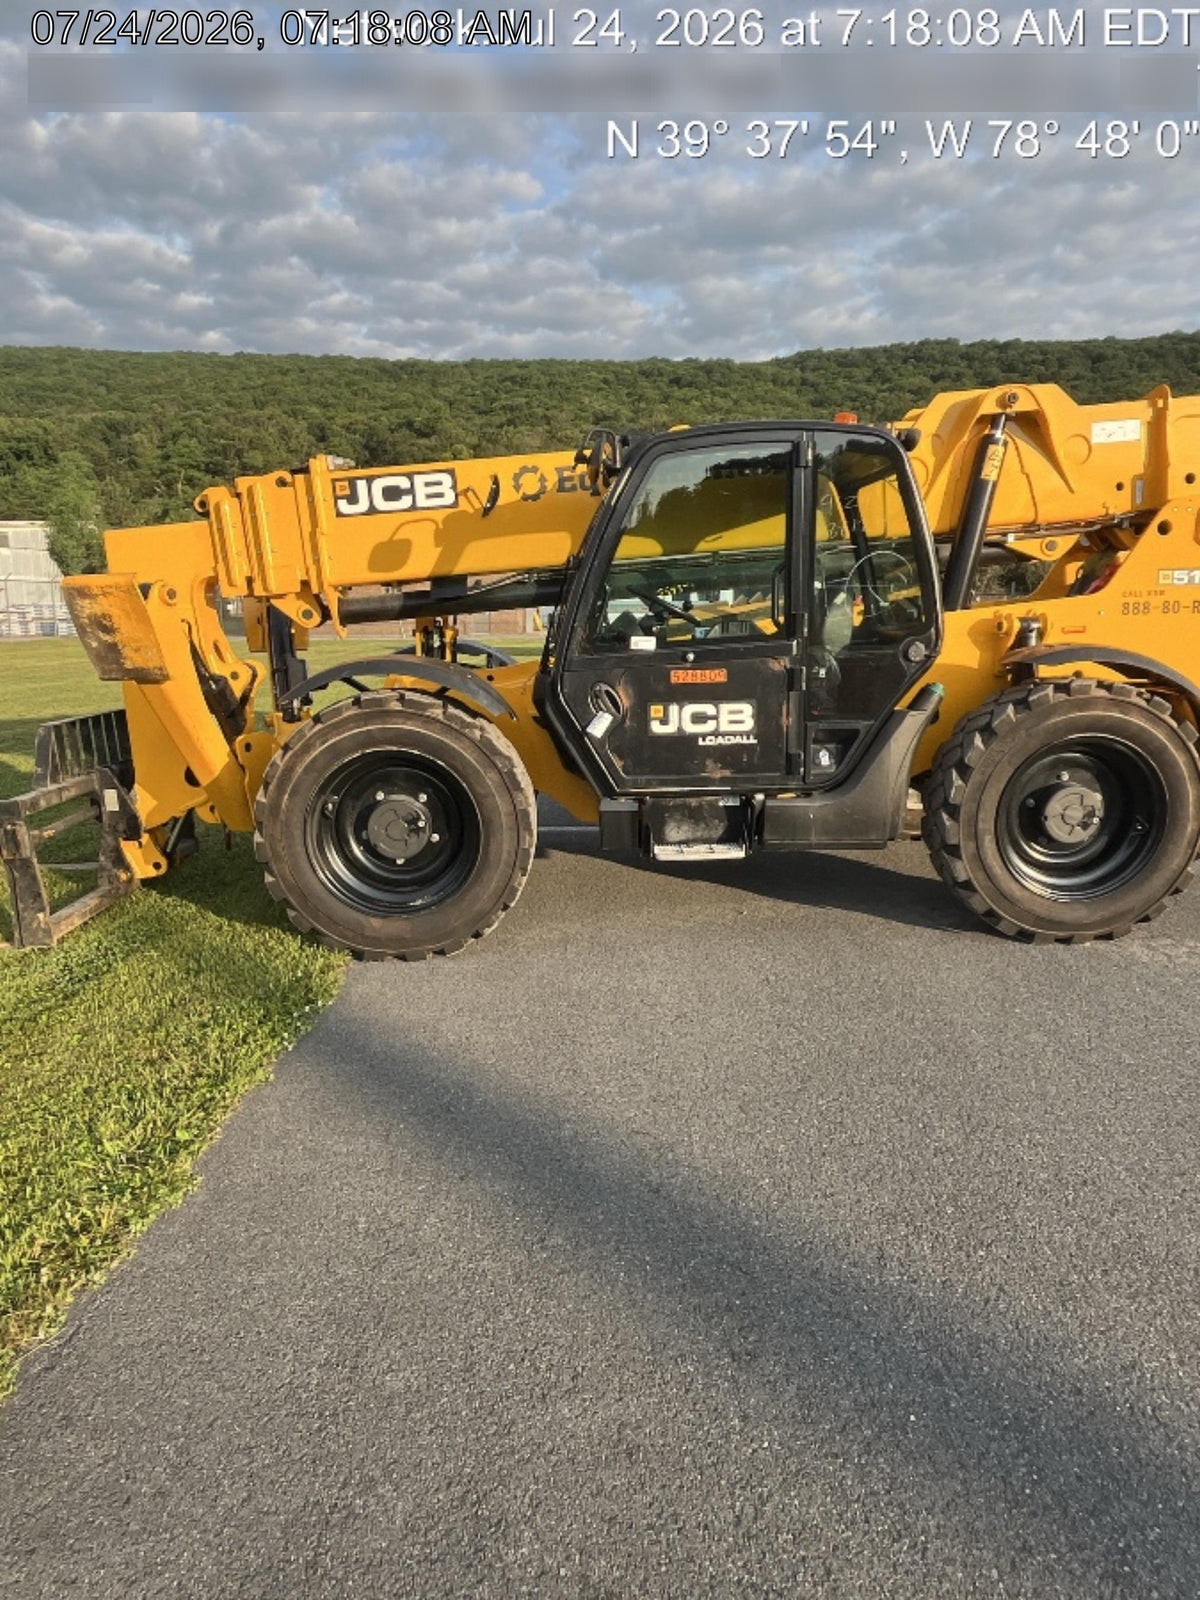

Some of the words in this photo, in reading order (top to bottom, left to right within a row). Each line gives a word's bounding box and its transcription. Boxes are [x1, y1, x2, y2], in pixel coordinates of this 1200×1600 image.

[335, 472, 456, 515] JCB
[650, 702, 755, 733] JCB
[698, 735, 758, 746] LOADALL
